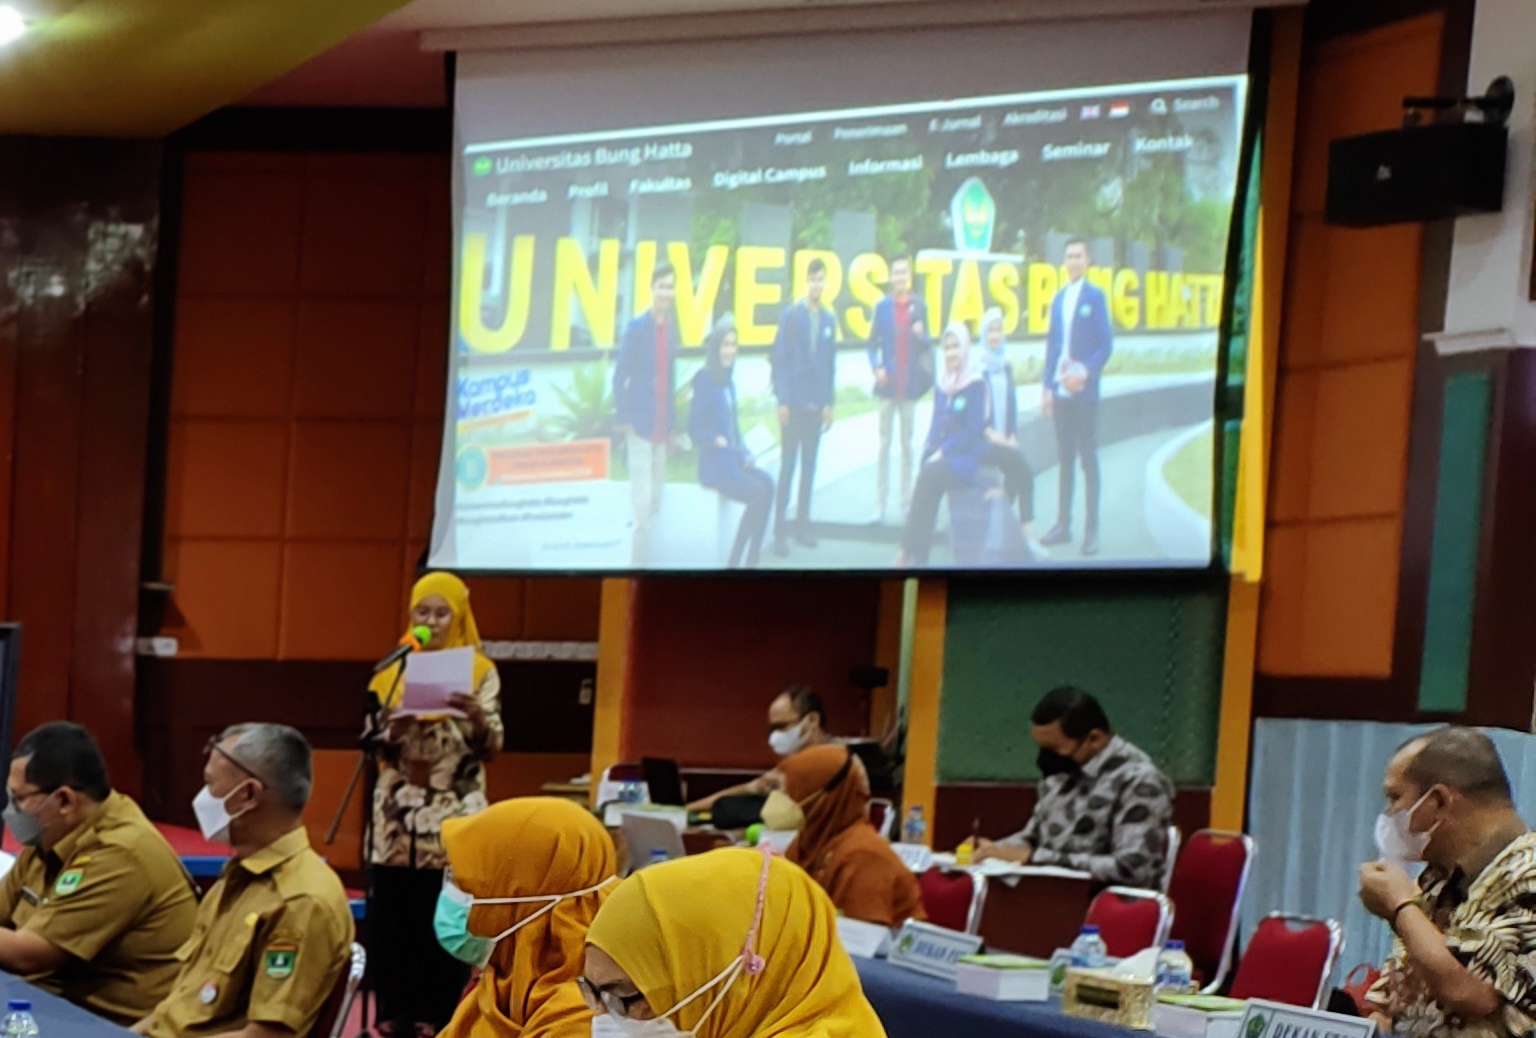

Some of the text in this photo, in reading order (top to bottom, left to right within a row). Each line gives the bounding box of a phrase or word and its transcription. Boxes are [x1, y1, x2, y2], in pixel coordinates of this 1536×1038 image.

[496, 141, 693, 175] Universitas Bung Hatta
[568, 182, 609, 199] Profil
[629, 176, 692, 193] Fakultas
[713, 169, 762, 188] Digital
[765, 165, 827, 185] Campus
[849, 154, 924, 175] Informasi
[945, 148, 1019, 169] Lembaga
[1042, 141, 1111, 161] Seminar
[1135, 135, 1194, 152] Kontak
